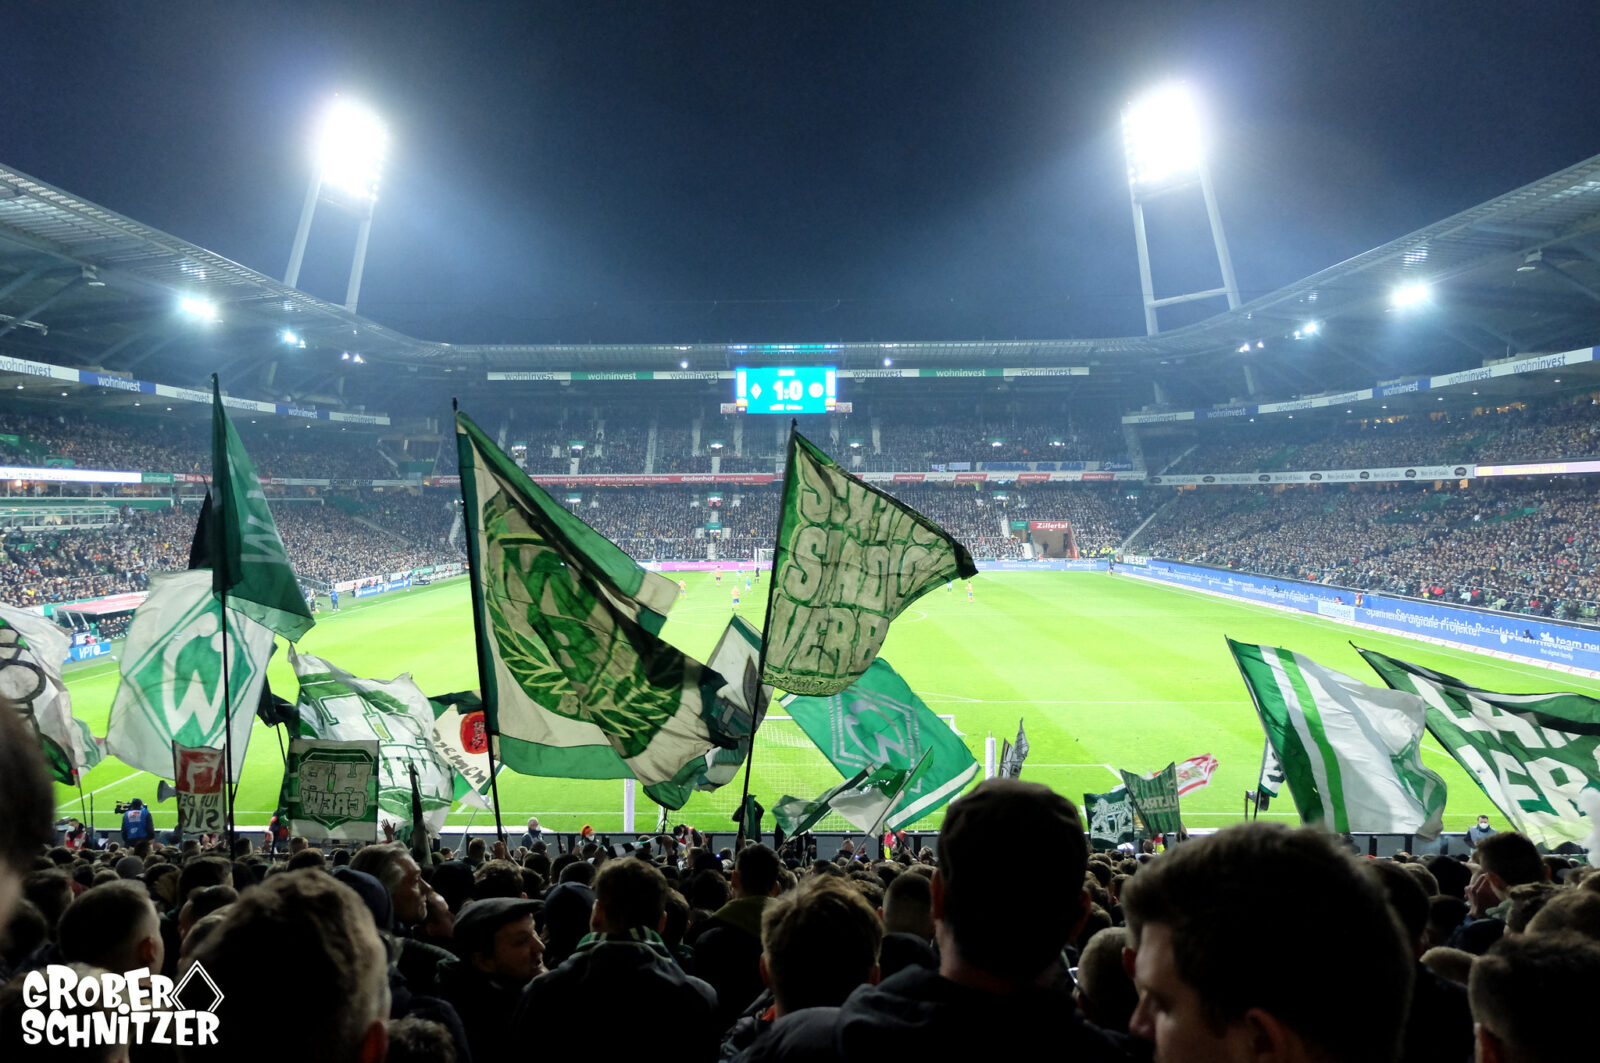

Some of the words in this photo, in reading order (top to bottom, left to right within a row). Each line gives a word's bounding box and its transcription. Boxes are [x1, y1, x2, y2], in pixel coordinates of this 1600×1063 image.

[1513, 354, 1566, 374] wohninvest
[588, 372, 637, 380] wohninvest
[936, 370, 986, 378] wohninvest
[1020, 368, 1072, 376] wohninvest
[1448, 368, 1492, 385] wohninvest
[97, 376, 141, 392] wohninvest
[773, 380, 803, 400] 1:0
[1383, 382, 1418, 397] wohninvest
[1207, 407, 1246, 418] wohninvest
[1036, 522, 1068, 530] Zillertal
